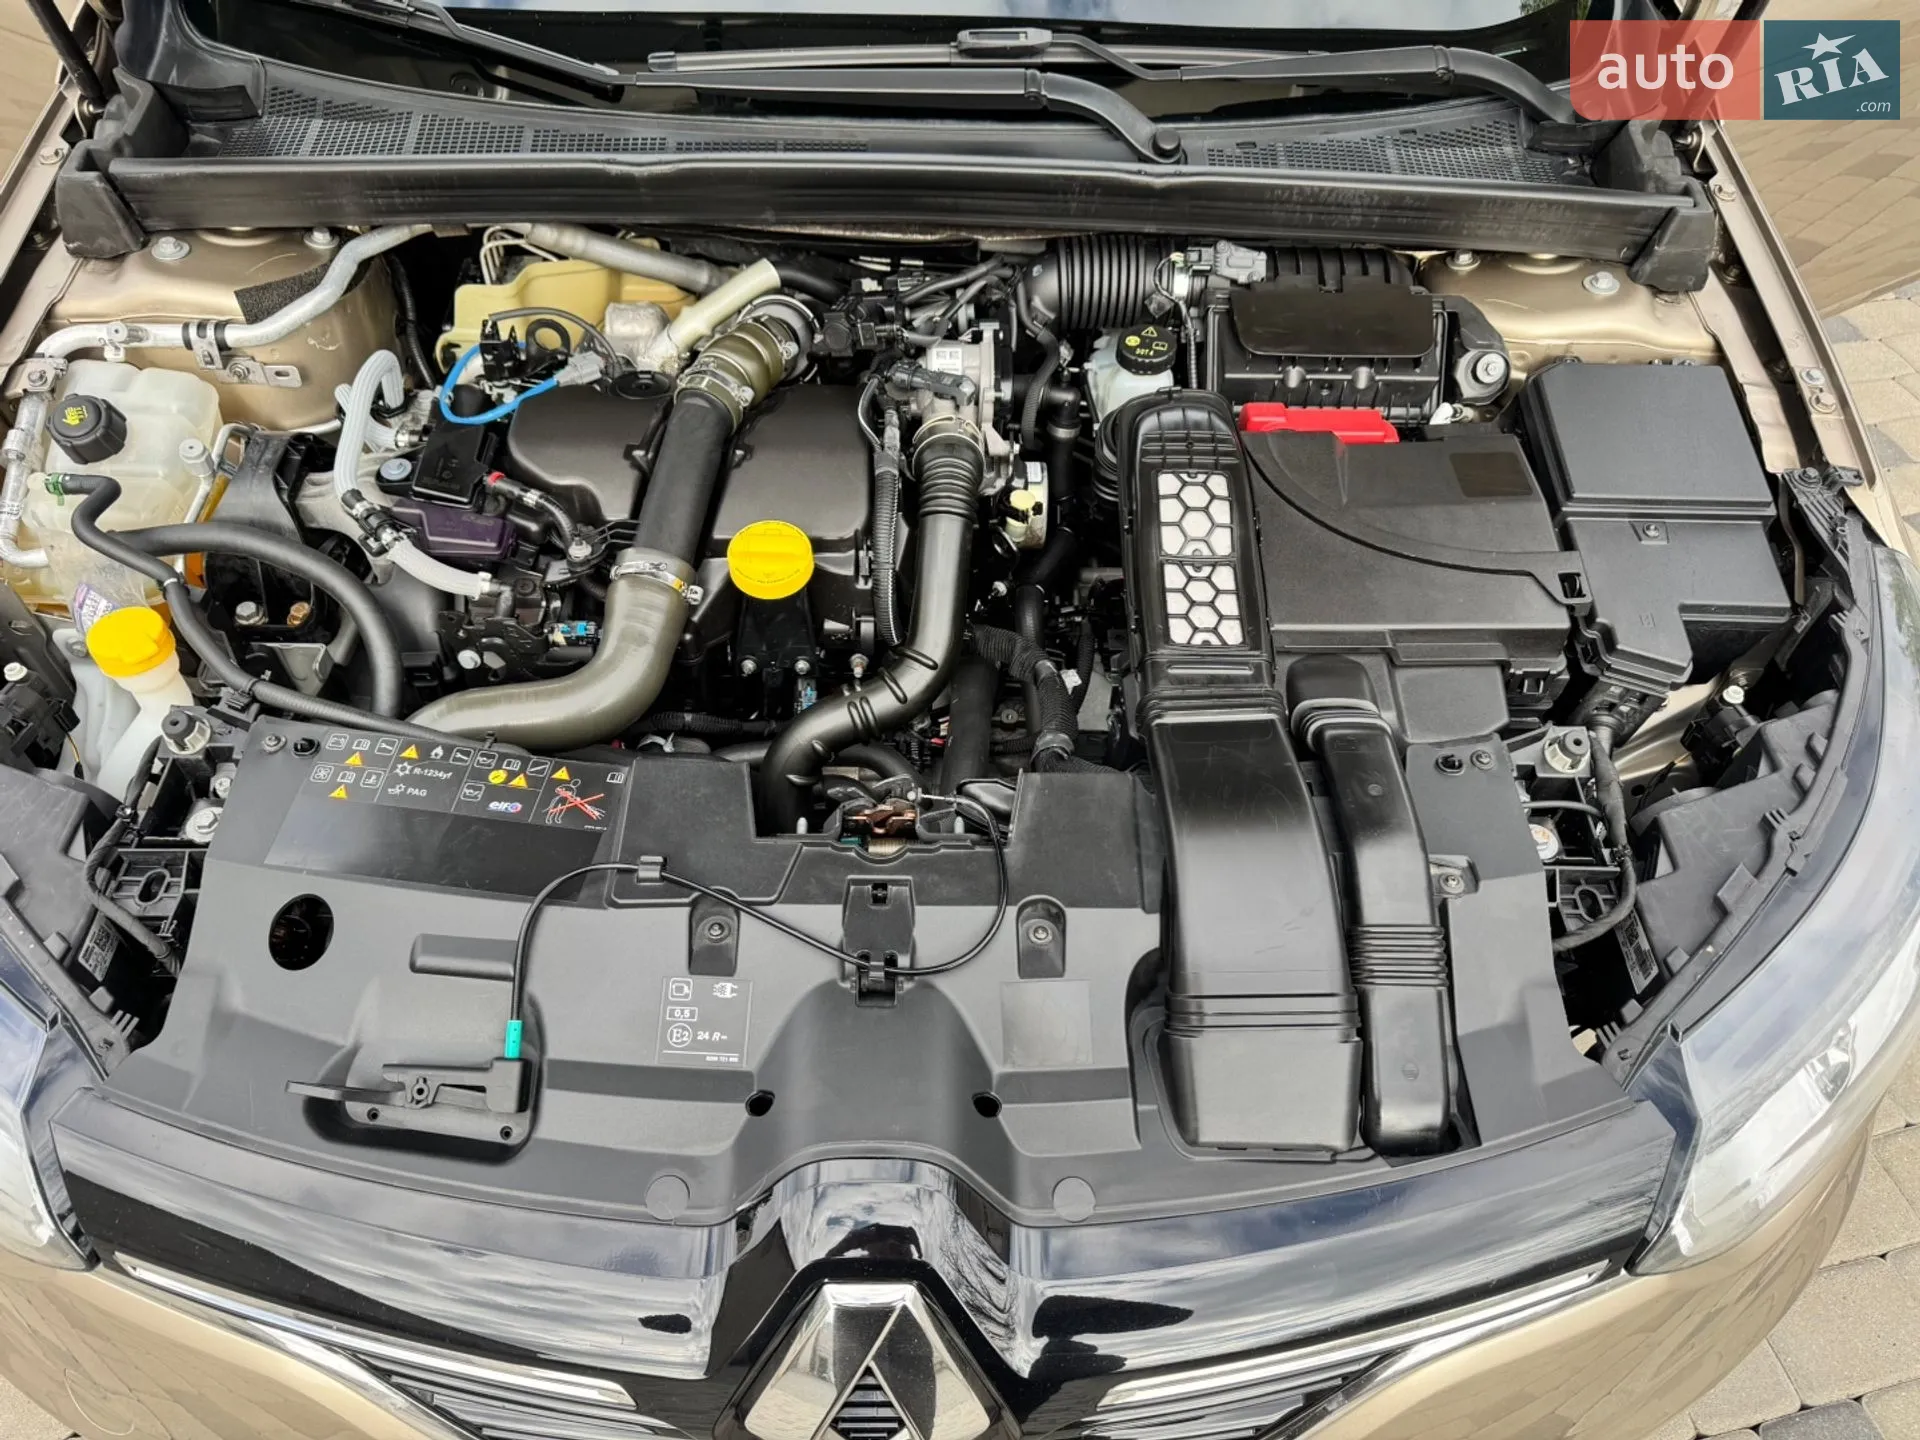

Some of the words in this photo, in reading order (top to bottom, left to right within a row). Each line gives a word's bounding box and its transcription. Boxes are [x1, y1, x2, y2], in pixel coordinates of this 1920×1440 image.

[413, 767, 453, 780] R-1234yf
[406, 787, 428, 797] PAG
[697, 1030, 710, 1041] 24
